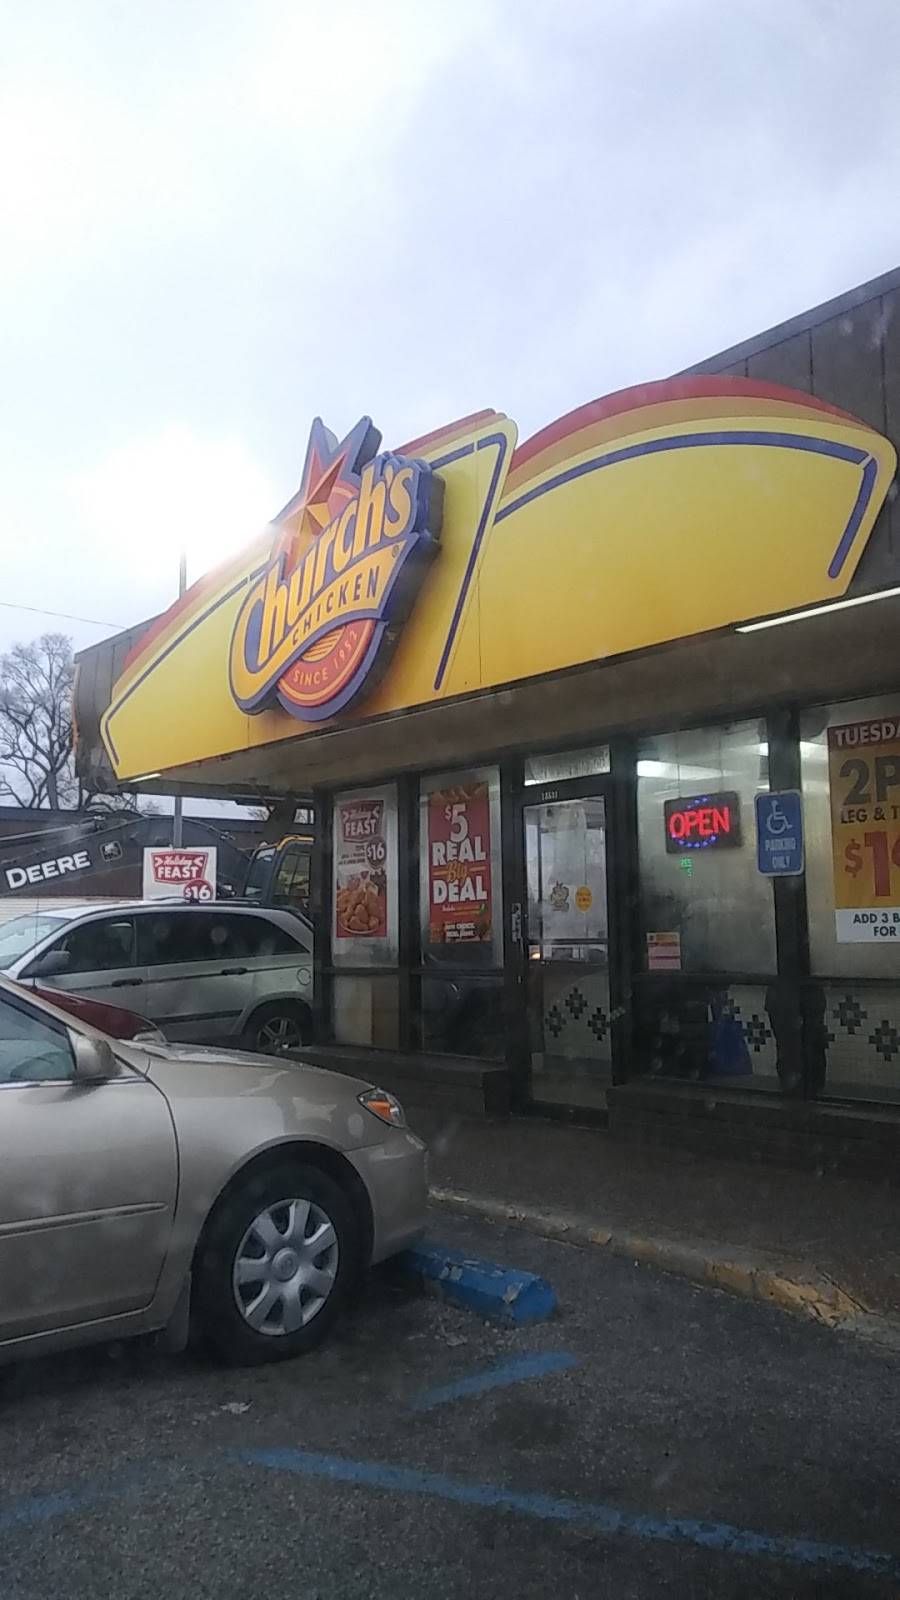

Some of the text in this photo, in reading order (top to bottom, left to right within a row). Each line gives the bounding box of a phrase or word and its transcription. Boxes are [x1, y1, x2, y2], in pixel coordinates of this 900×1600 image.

[229, 462, 414, 700] Church's
[291, 566, 380, 645] CHICKEN
[293, 630, 358, 687] SINCE 1952
[444, 803, 469, 842] $5
[669, 806, 731, 838] OPEN
[840, 806, 868, 825] LEG
[872, 805, 887, 822] &
[344, 819, 377, 837] FEAST
[367, 842, 385, 861] $16
[431, 836, 487, 866] REAL
[764, 837, 796, 852] PARKING
[5, 850, 91, 890] DEERE
[157, 865, 199, 879] FEAST
[184, 885, 211, 900] $16
[432, 875, 488, 905] DEAL
[852, 912, 878, 925] ADD
[881, 912, 889, 924] 3
[873, 925, 896, 938] FOR
